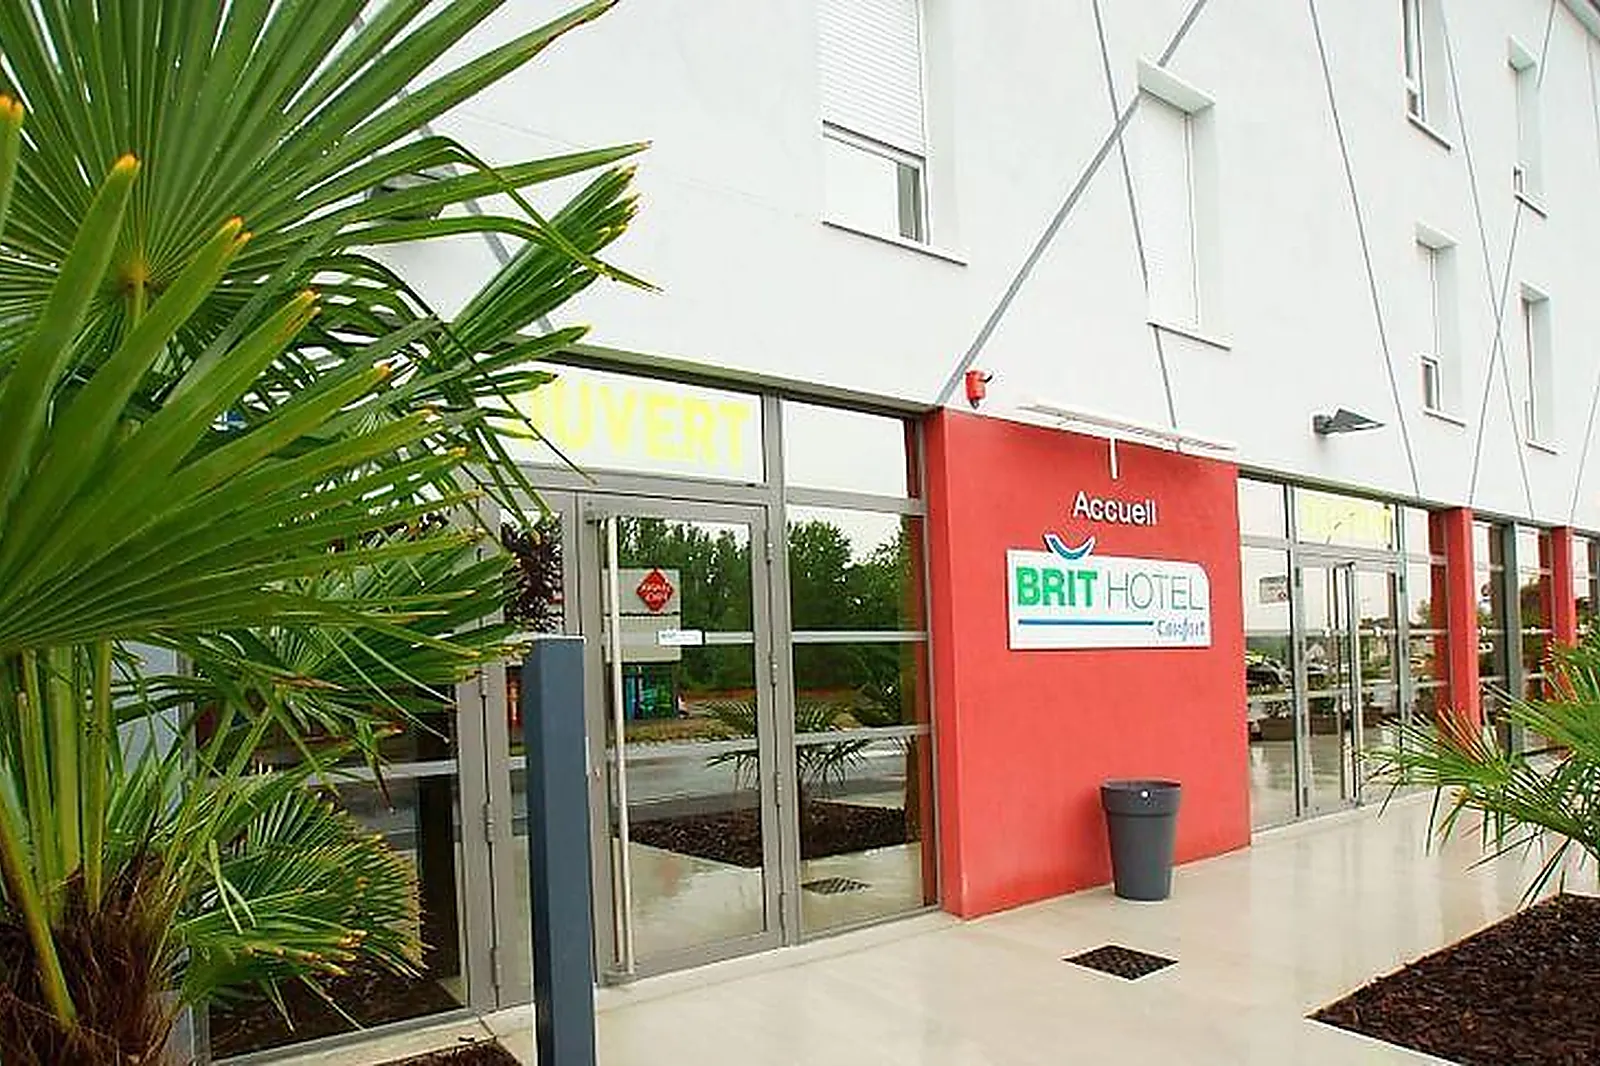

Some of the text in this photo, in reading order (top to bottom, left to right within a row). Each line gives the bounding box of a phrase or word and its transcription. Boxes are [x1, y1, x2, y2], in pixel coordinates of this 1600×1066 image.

[1072, 491, 1157, 525] Accueil
[1015, 567, 1205, 611] BRIT HOTEL
